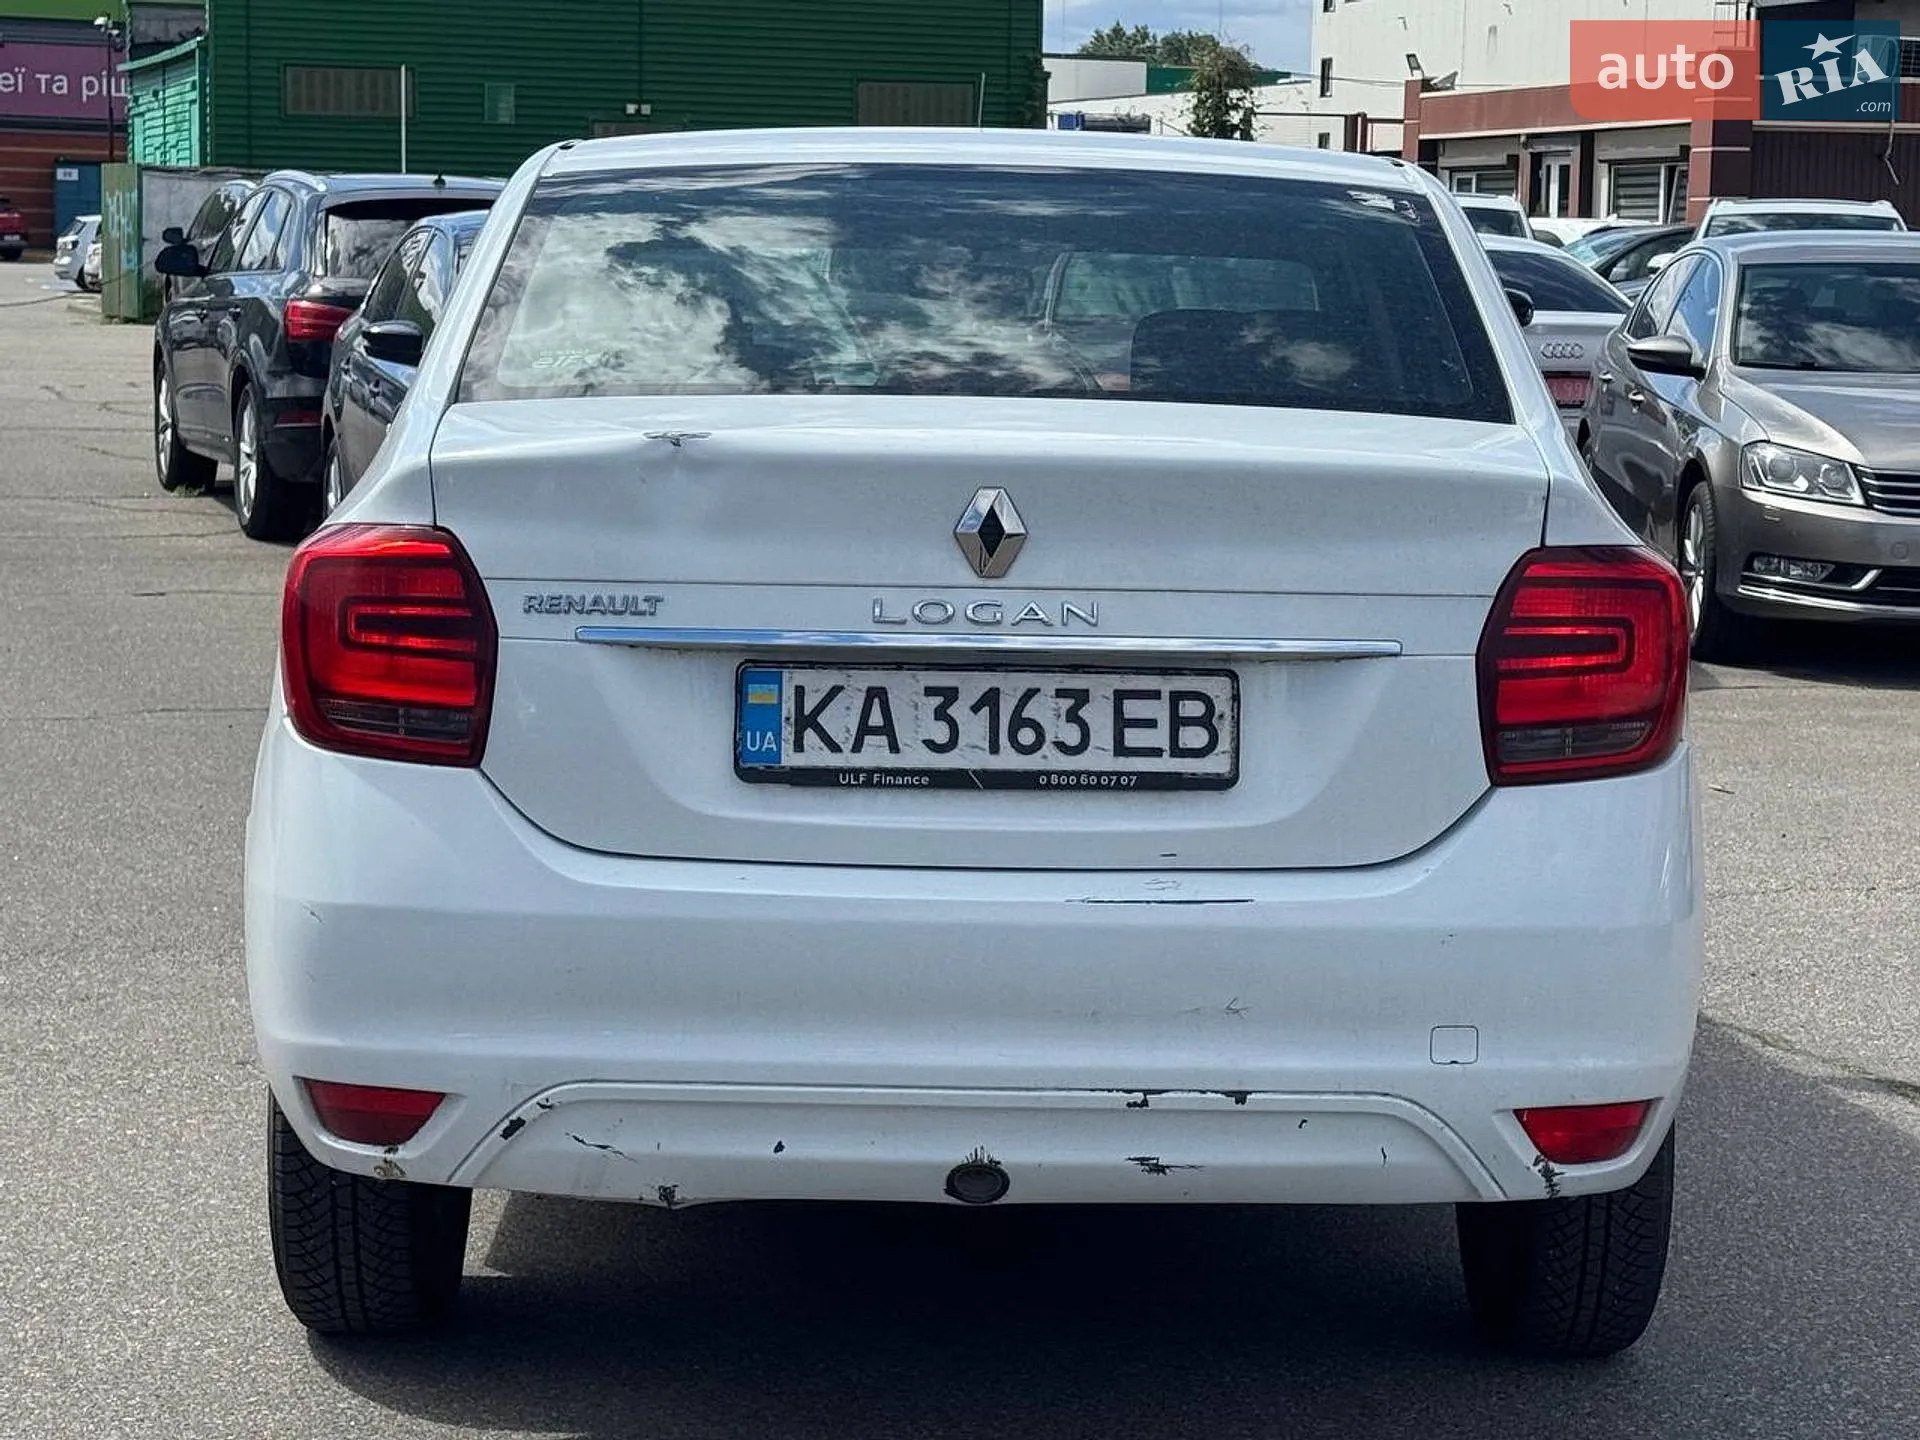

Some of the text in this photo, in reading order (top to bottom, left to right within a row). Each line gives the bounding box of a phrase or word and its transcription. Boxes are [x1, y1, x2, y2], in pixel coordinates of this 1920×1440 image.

[35, 73, 68, 95] та
[523, 594, 664, 616] RENAULT
[872, 599, 1100, 627] LOGAN
[793, 685, 1220, 758] KA 3163 EB
[746, 731, 777, 751] UA
[839, 772, 930, 785] ULF Finance
